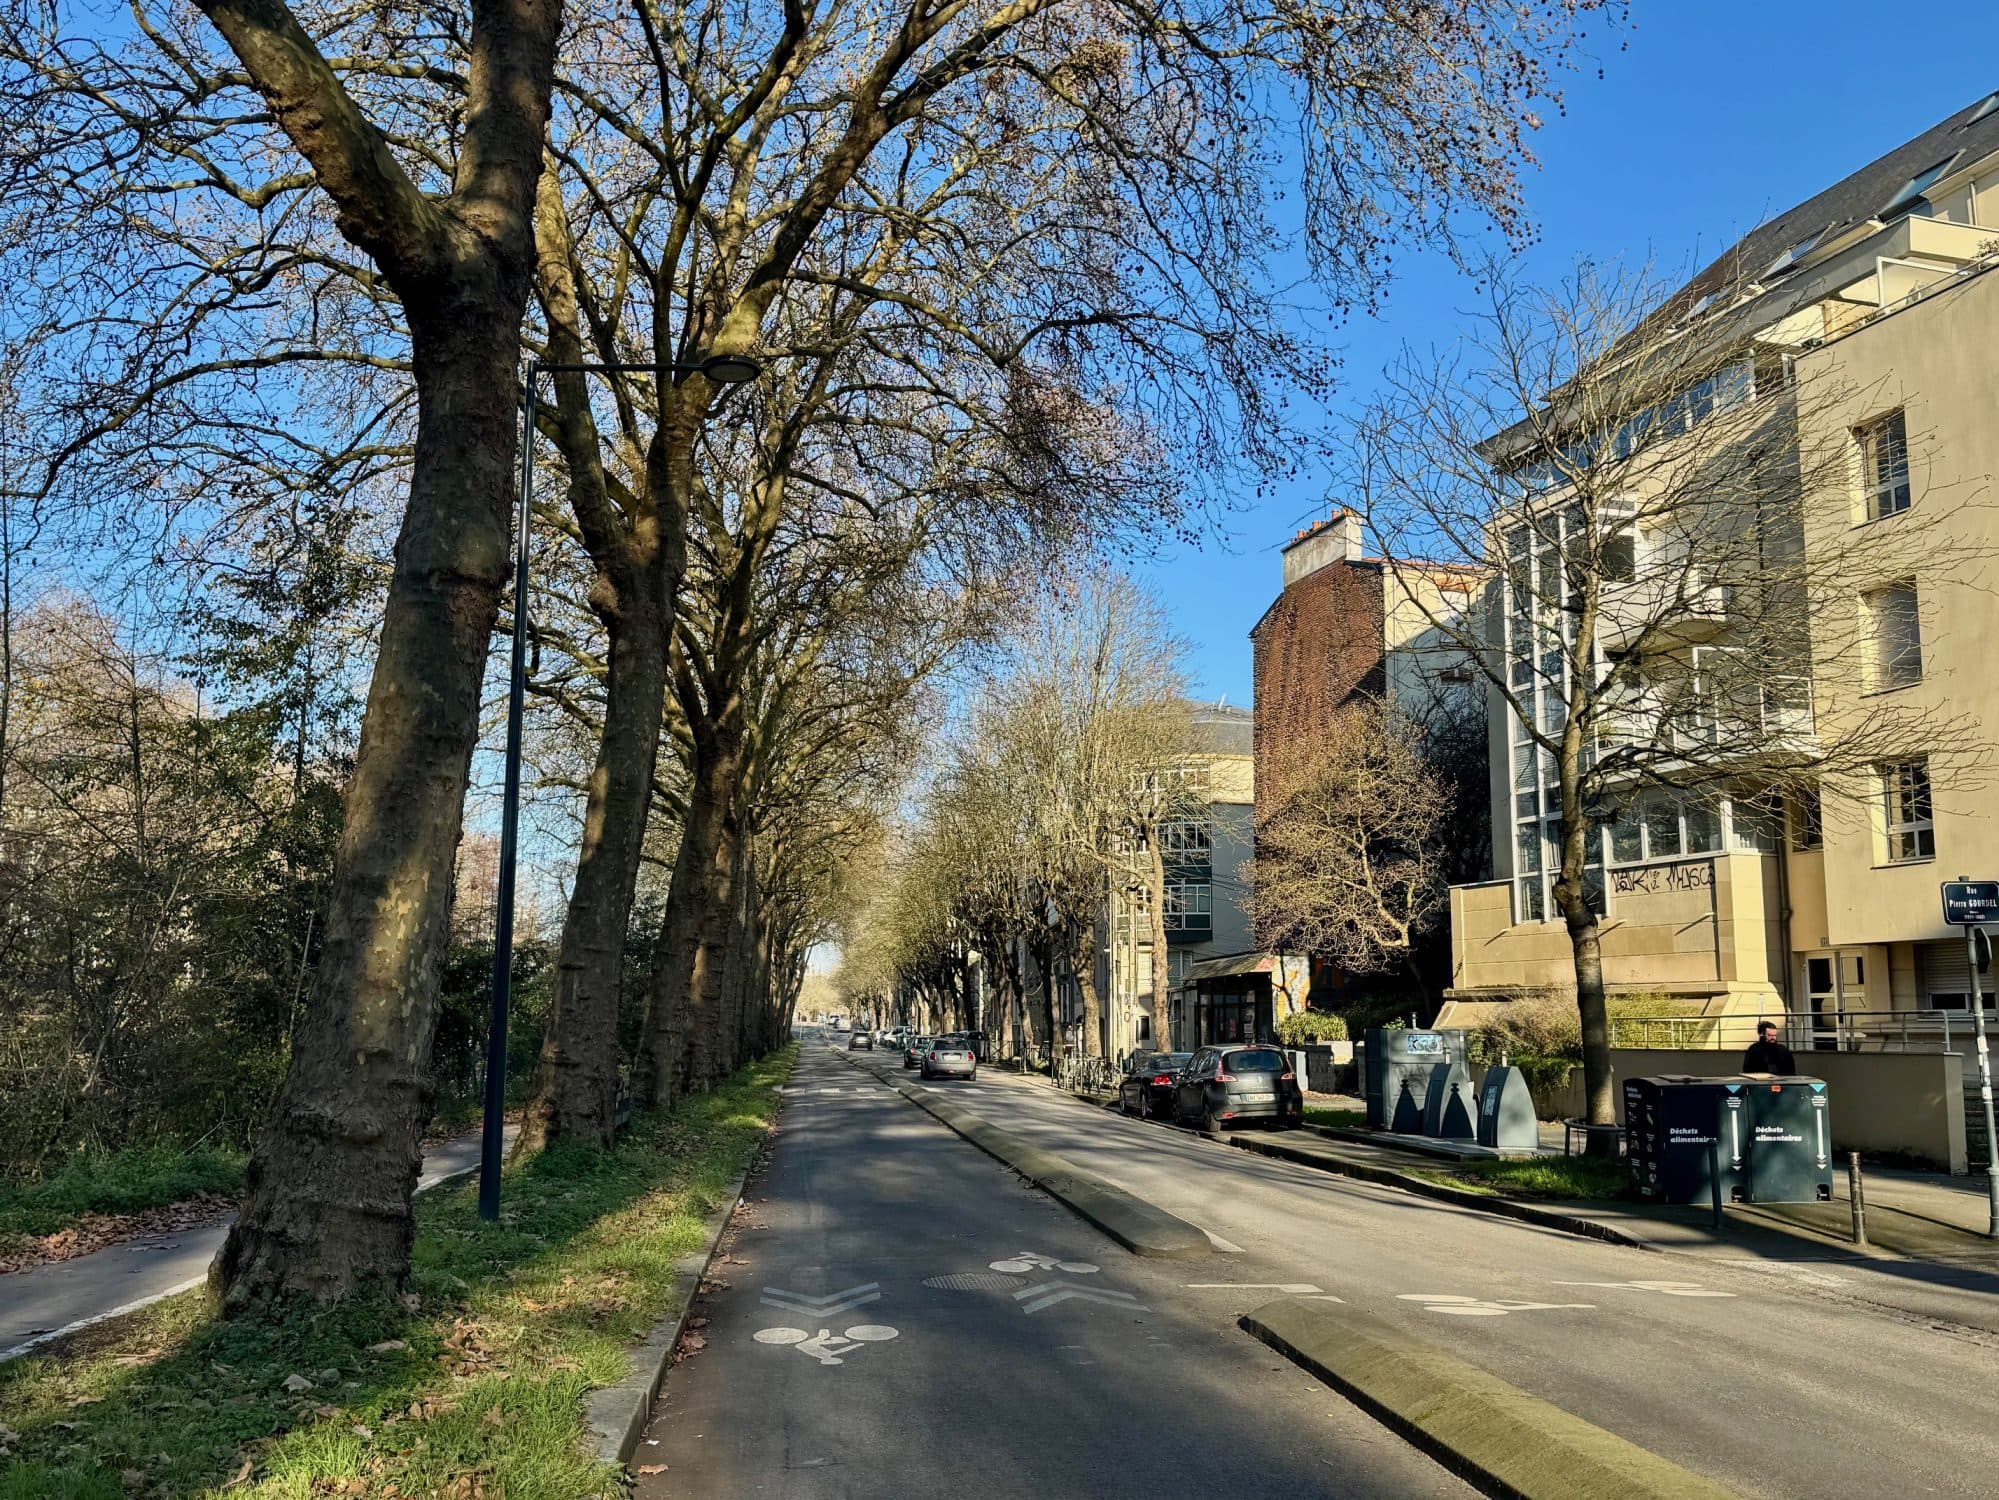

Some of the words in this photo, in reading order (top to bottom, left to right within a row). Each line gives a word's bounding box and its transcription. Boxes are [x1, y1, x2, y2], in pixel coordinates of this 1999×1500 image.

[1966, 886, 1977, 895] Rue
[1949, 899, 1967, 908] Pierre
[1670, 1127, 1699, 1135] Déchets
[1755, 1134, 1803, 1142] alimentaires
